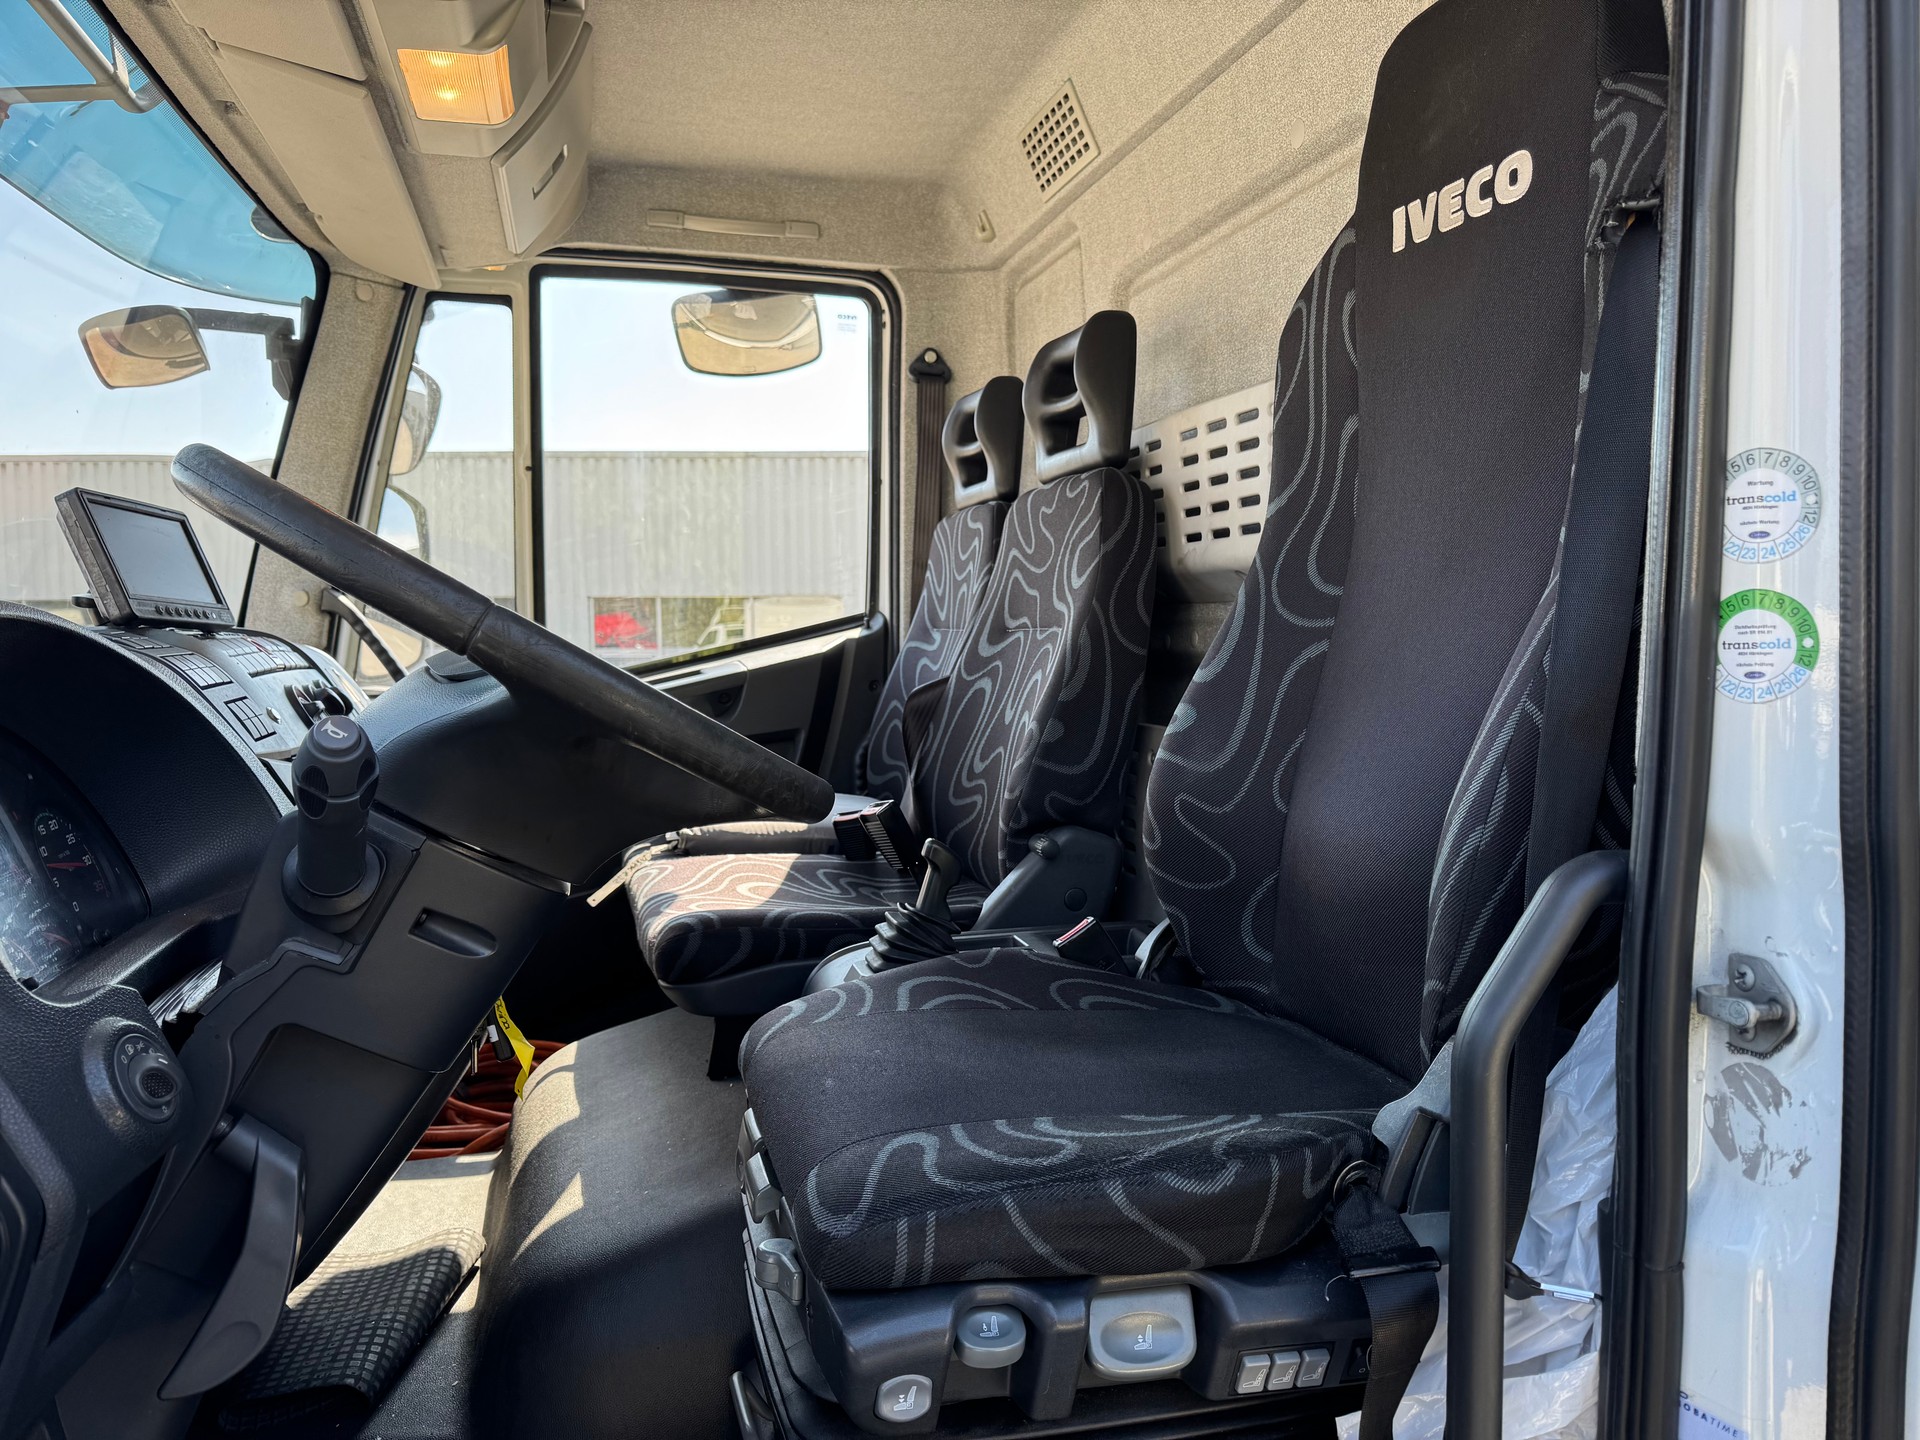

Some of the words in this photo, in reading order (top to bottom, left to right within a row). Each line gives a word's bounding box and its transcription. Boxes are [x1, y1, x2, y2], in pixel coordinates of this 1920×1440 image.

[1392, 150, 1533, 253] IVECO
[1746, 453, 1755, 466] 6
[1764, 452, 1773, 464] 7
[1780, 455, 1791, 468] 8
[1730, 460, 1740, 473] 5
[1793, 464, 1805, 476] 9
[1801, 475, 1816, 490] 10
[1726, 491, 1796, 505] transcold
[1803, 510, 1817, 524] 12
[1793, 525, 1810, 540] 26
[1724, 542, 1740, 556] 22
[1741, 547, 1756, 560] 23
[1761, 546, 1776, 559] 24
[1779, 540, 1796, 554] 25
[1741, 594, 1750, 606] 6
[1759, 593, 1768, 605] 7
[1774, 598, 1785, 609] 8
[1726, 601, 1736, 613] 5
[1787, 607, 1800, 618] 9
[1796, 618, 1811, 633] 10
[1722, 638, 1792, 650] transcold
[1799, 654, 1813, 667] 12
[1789, 666, 1807, 683] 26
[1721, 680, 1737, 694] 22
[1737, 686, 1752, 699] 23
[1757, 687, 1772, 699] 24
[1774, 680, 1792, 693] 25
[48, 819, 59, 831] 20
[65, 833, 76, 845] 25
[39, 846, 48, 857] 10
[52, 877, 60, 888] 5
[72, 901, 80, 913] 0
[1679, 1402, 1738, 1437] OBATIME
